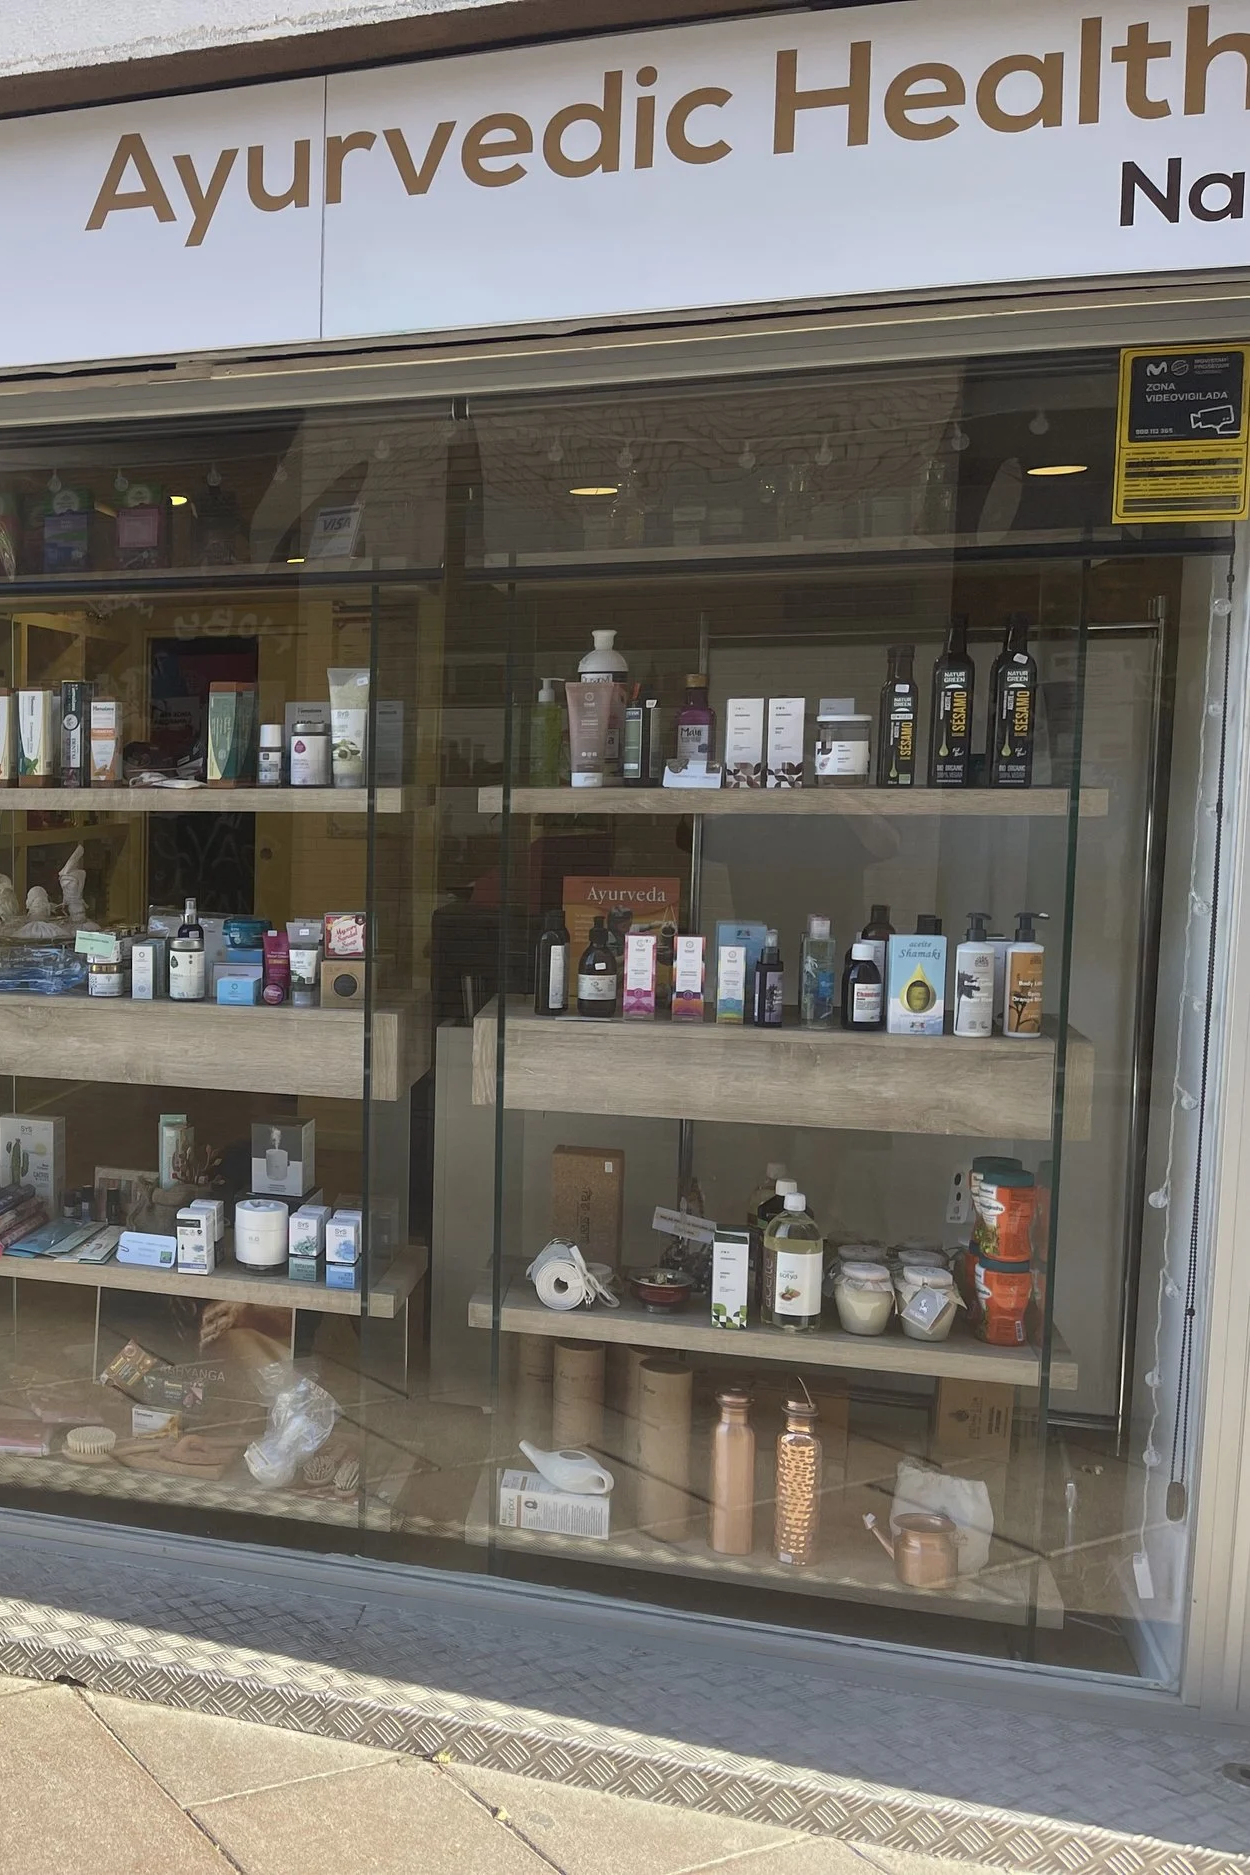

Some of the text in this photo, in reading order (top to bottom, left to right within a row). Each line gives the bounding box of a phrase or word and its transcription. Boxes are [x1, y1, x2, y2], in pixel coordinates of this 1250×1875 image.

[84, 4, 1250, 247] Ayurvedic Health
[1145, 382, 1176, 392] ZONA
[1145, 391, 1229, 402] VIDEOVIGILADA
[950, 691, 967, 732] SÉSAMO
[1013, 690, 1030, 732] SÉSAMO
[898, 721, 913, 756] SÉSAMO
[587, 886, 667, 905] Ayurveda
[898, 949, 942, 960] Shamaki
